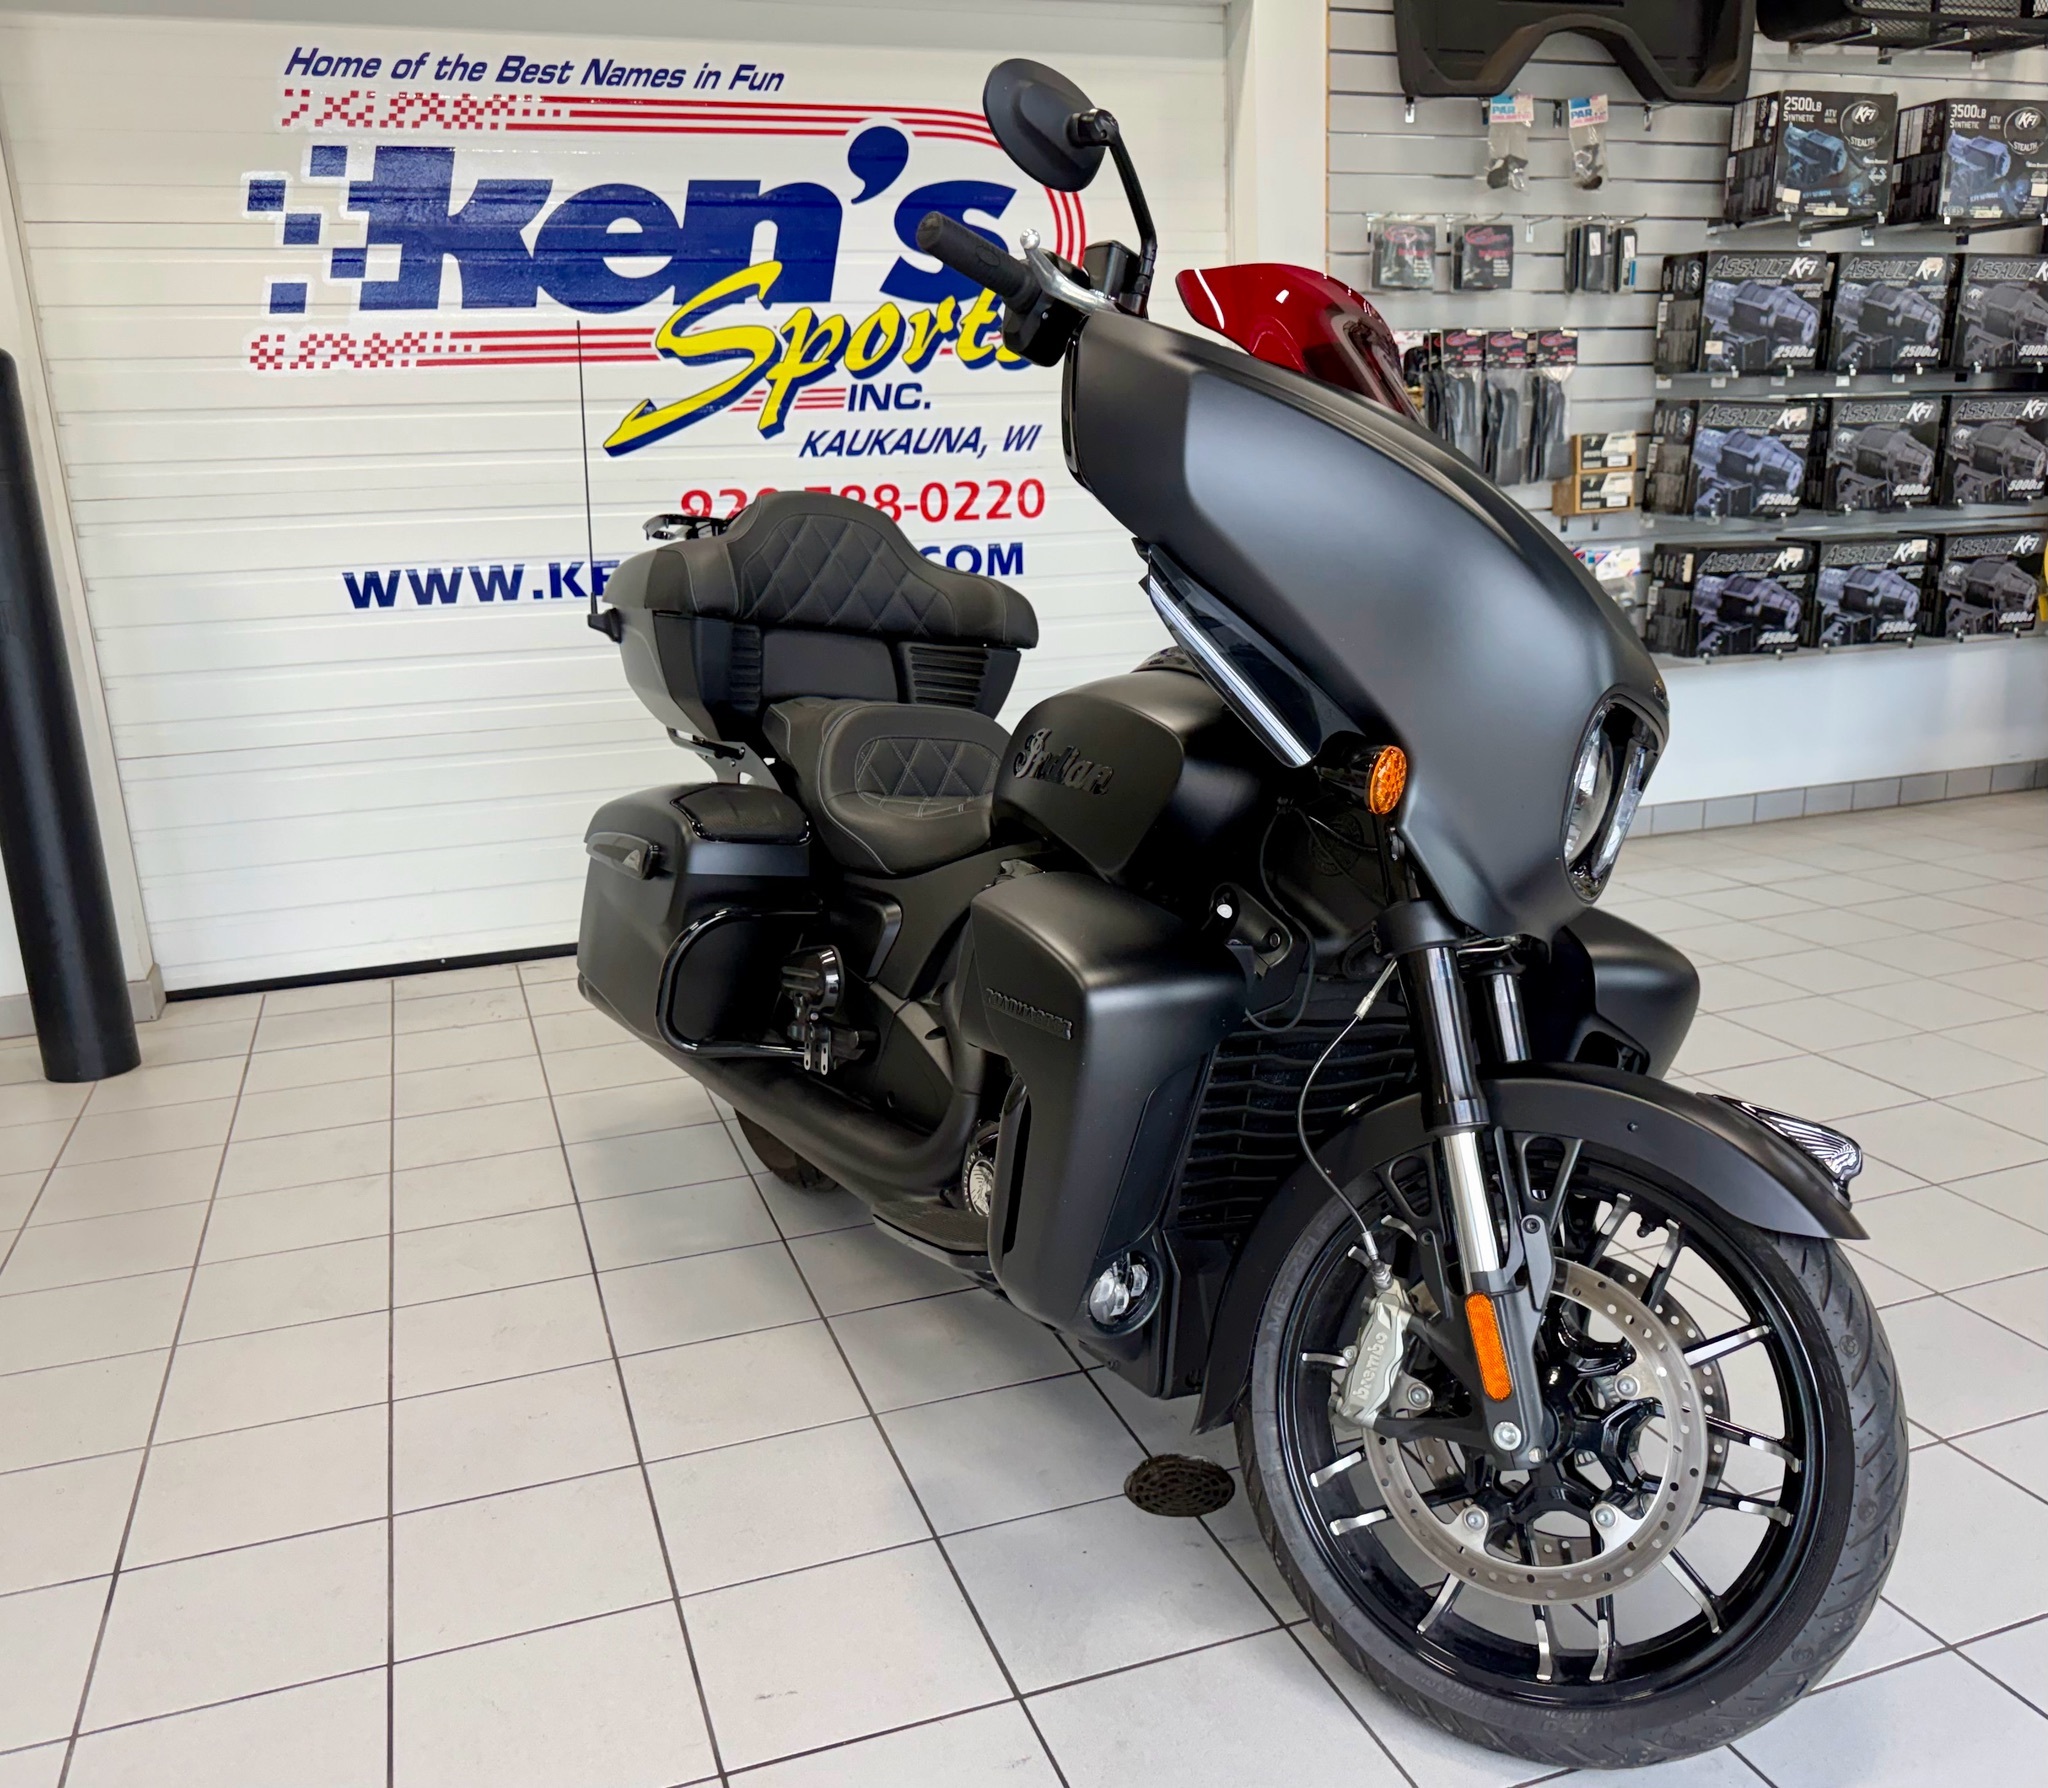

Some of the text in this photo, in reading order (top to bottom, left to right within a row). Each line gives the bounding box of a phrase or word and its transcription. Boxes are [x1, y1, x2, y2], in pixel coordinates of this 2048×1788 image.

[284, 47, 785, 92] Home of the Best Names in Fun
[1783, 96, 1822, 112] 2500LB
[1825, 109, 1837, 118] ATV
[1950, 104, 1987, 119] 3500LB
[1989, 115, 2002, 124] ATV
[1850, 136, 1876, 147] STEALTH
[2013, 141, 2038, 152] STEALTH
[347, 126, 1017, 314] ken's
[1708, 255, 1792, 277] ASSAULT
[1840, 257, 1919, 279] ASSAULT
[1967, 258, 2048, 282] ASSAULT K
[603, 261, 1036, 457] Sport
[1774, 344, 1816, 358] 2500LB
[1900, 344, 1939, 358] 2500LB
[847, 382, 932, 412] INC.
[1699, 404, 1780, 427] ASSAULT
[1835, 402, 1910, 422] ASSAULT
[1952, 400, 2026, 420] ASSAULT
[798, 424, 1043, 459] KAUKAUNA, WI
[680, 478, 1045, 524] 928-0220
[1946, 536, 2018, 557] ASSAULT
[1697, 551, 1778, 573] ASSAULT
[1012, 727, 1115, 796] Indian
[1352, 1331, 1388, 1400] brembo
